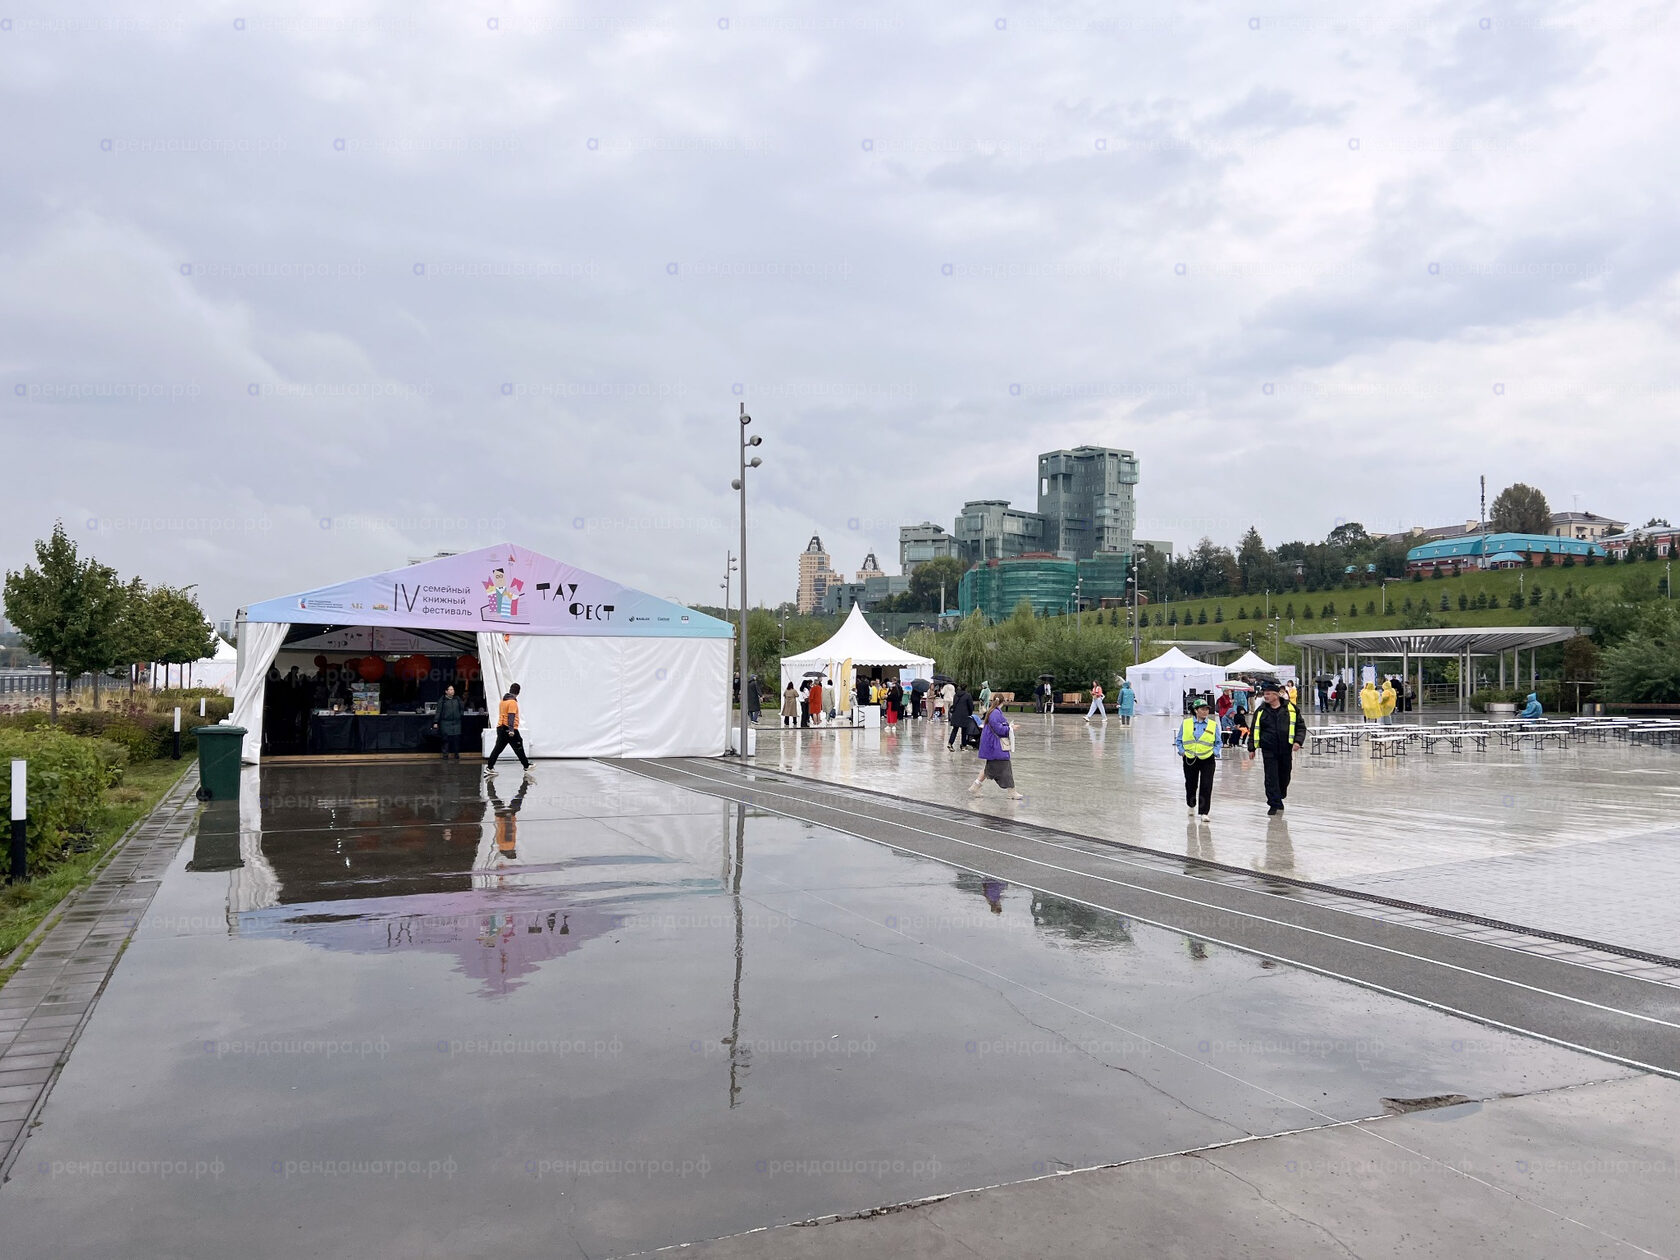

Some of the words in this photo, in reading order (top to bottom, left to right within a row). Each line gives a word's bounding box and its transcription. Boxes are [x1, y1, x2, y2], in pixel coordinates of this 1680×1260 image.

[422, 585, 471, 594] семейный
[536, 582, 578, 602] ТАУ
[394, 583, 421, 613] IV
[422, 596, 466, 605] книжный
[422, 605, 473, 616] фестиваль
[568, 602, 615, 621] ФЕСТ
